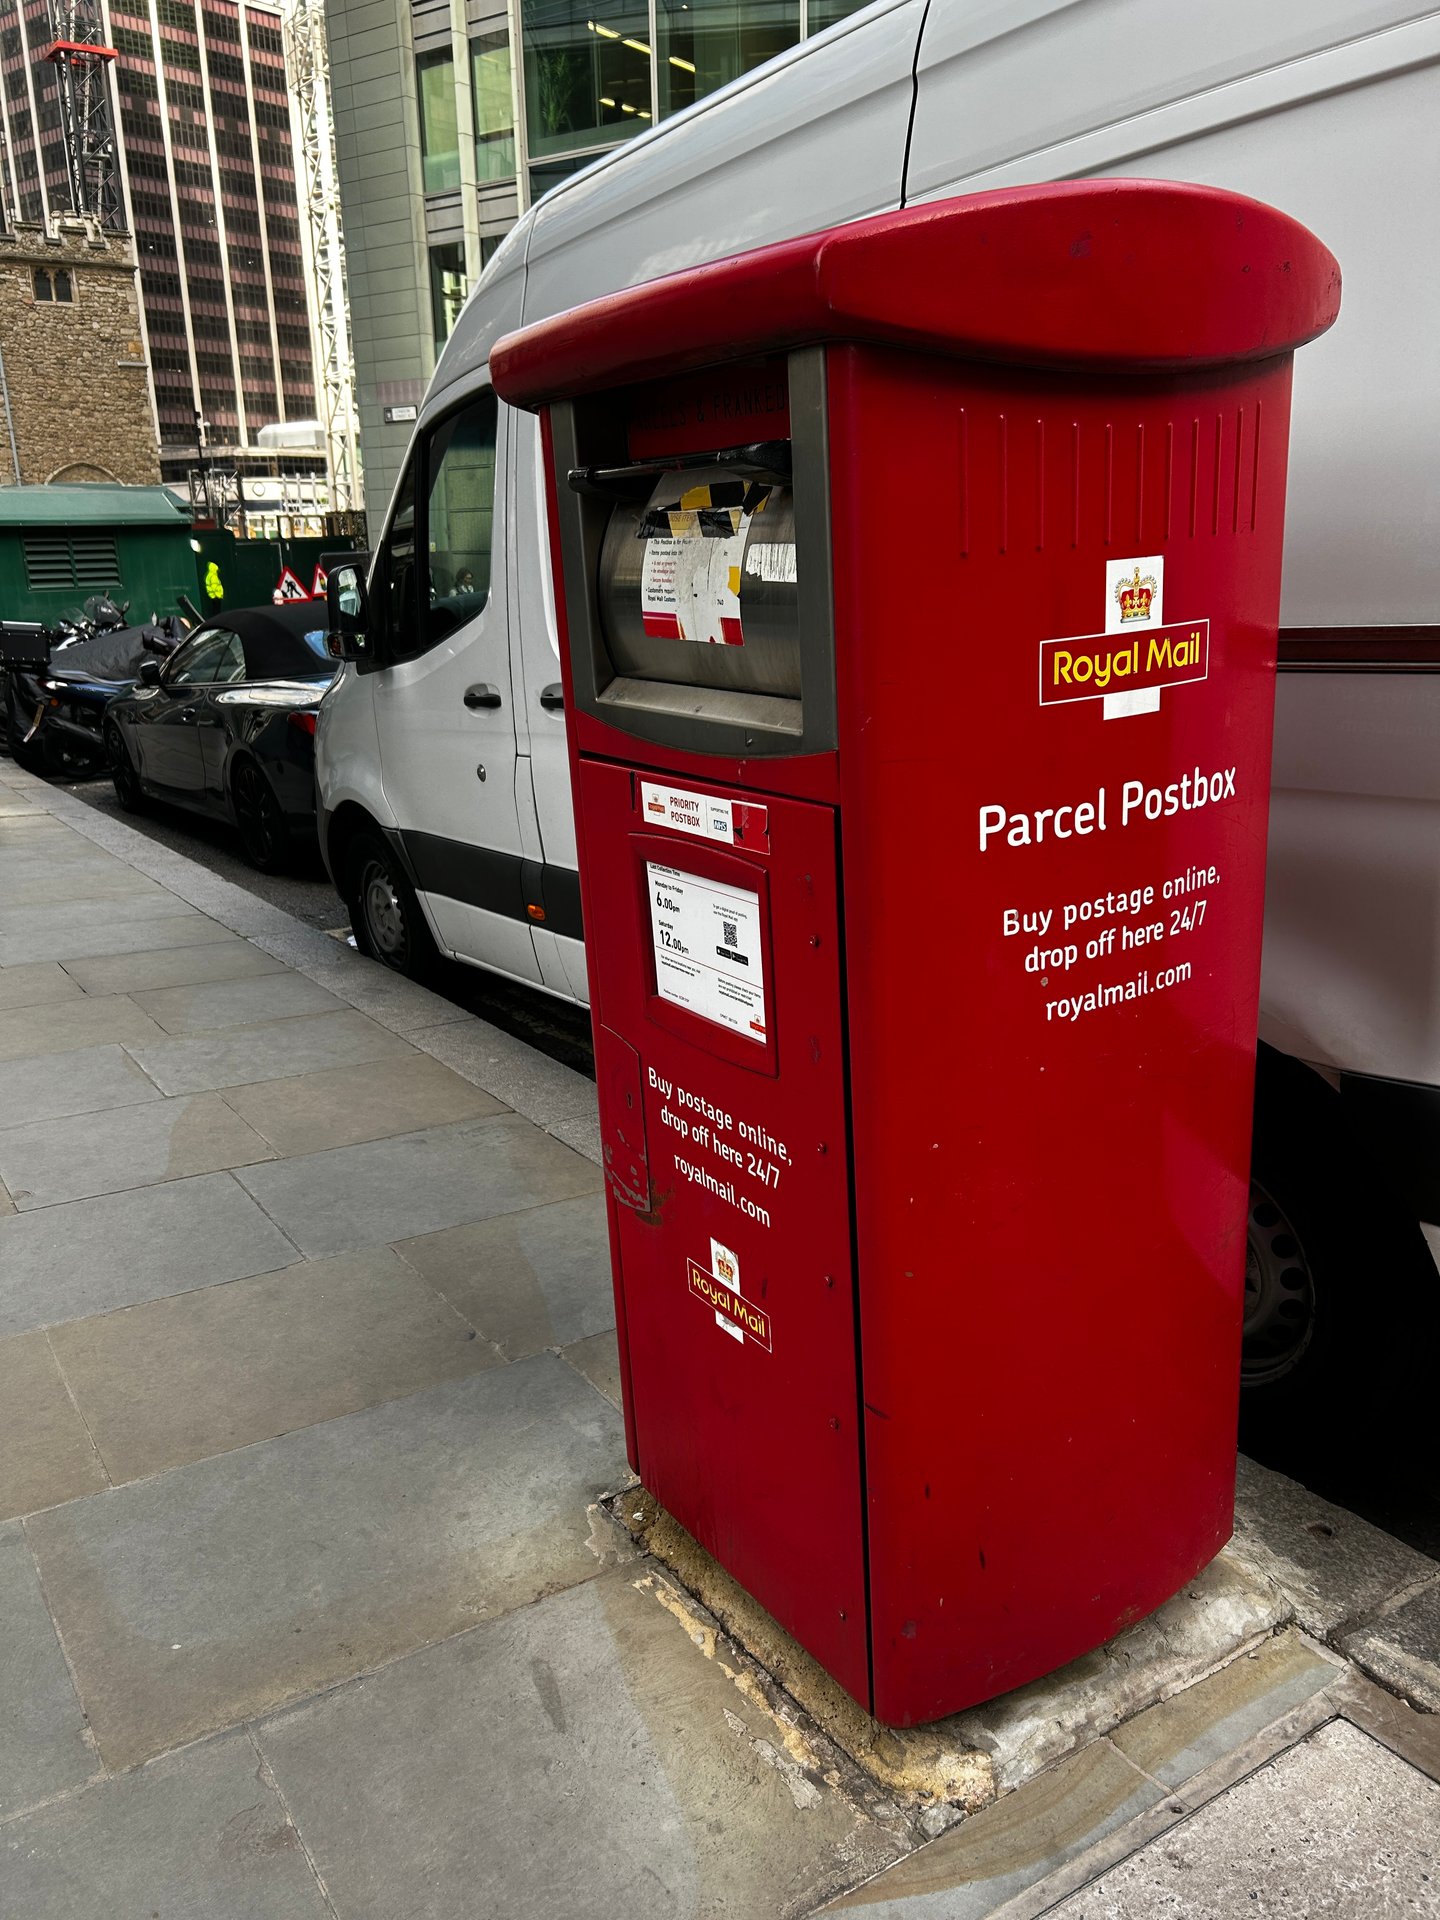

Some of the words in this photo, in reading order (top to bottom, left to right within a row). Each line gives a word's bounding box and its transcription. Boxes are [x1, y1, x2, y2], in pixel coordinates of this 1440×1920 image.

[714, 384, 786, 418] FRANKED
[1053, 641, 1138, 687] Royal
[1146, 632, 1200, 672] Mail
[669, 796, 700, 813] PRIORITY
[670, 811, 700, 828] POSTBOX
[714, 820, 727, 832] NHS
[979, 787, 1106, 852] Parcel
[1122, 766, 1236, 826] Postbox
[655, 880, 668, 891] Monday
[672, 885, 683, 895] Friday
[656, 892, 680, 913] 6.00pm
[1003, 908, 1052, 936] Buy
[1064, 886, 1154, 930] postage
[1162, 865, 1220, 900] online,
[658, 920, 673, 931] Saturday
[660, 930, 689, 954] 12.00pm
[1024, 946, 1078, 972] drop
[1086, 928, 1116, 959] off
[1122, 922, 1164, 950] here
[1169, 900, 1207, 936] 24/7
[1046, 961, 1192, 1022] royalmail.com
[648, 1066, 672, 1100] Buy
[677, 1087, 733, 1130] postage
[738, 1121, 792, 1166] online,
[661, 1105, 688, 1138] drop
[692, 1125, 709, 1148] off
[712, 1132, 743, 1168] here
[747, 1152, 780, 1189] 24/7
[674, 1154, 770, 1228] royalmail.com
[692, 1268, 731, 1312] Royal
[734, 1298, 765, 1337] Mail
